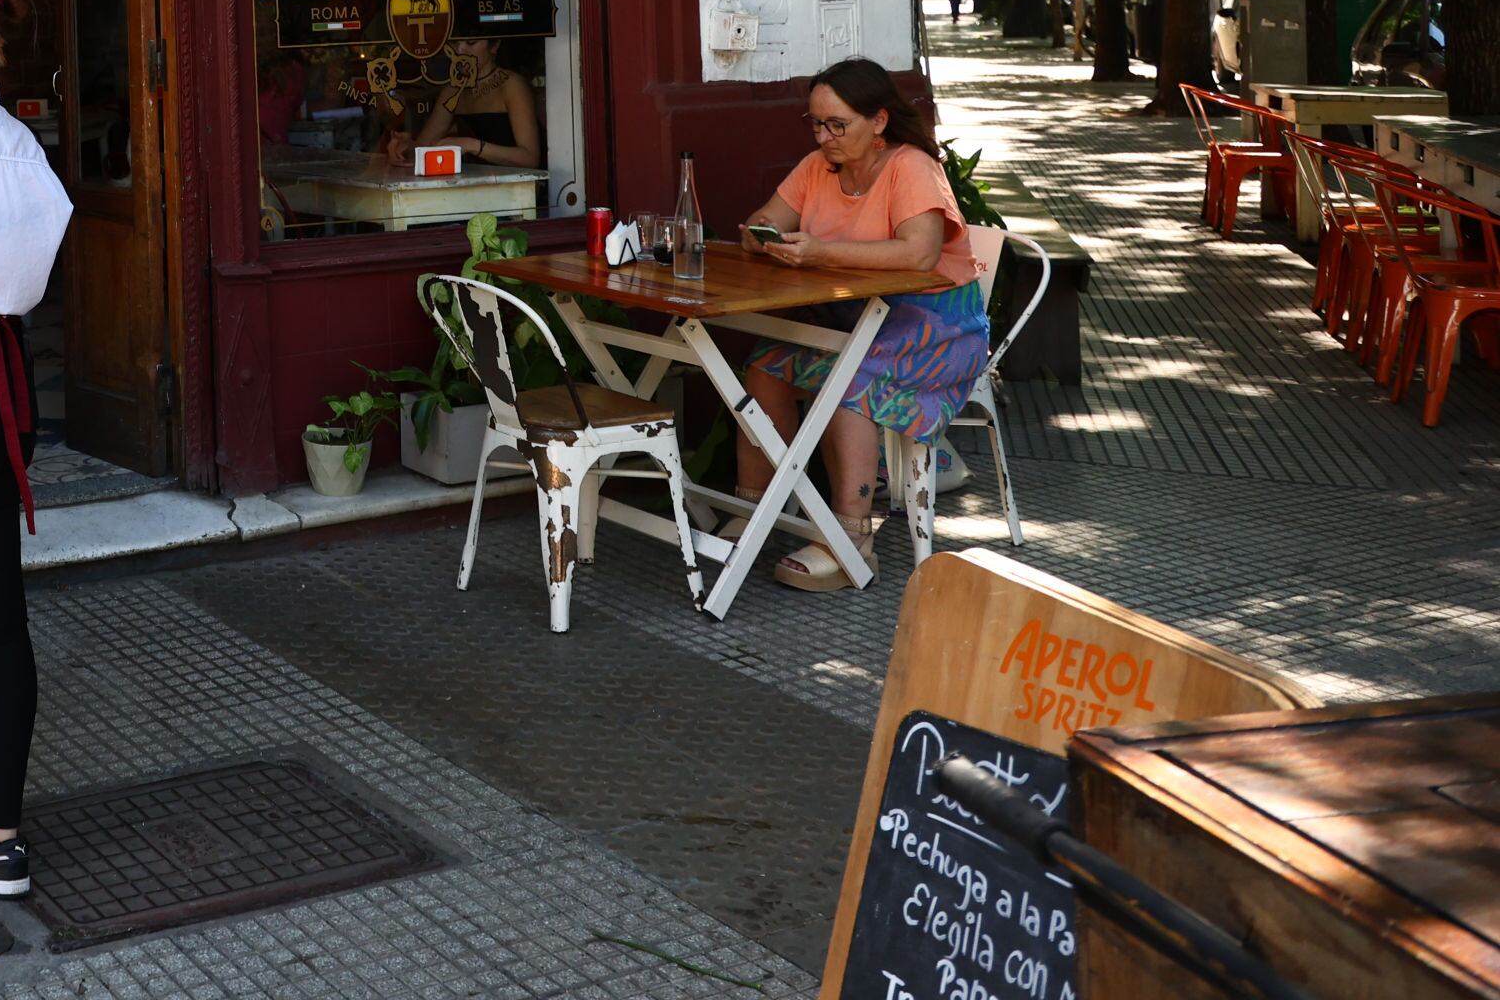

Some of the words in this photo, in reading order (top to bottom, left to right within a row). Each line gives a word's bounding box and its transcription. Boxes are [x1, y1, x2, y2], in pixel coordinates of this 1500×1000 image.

[311, 6, 360, 20] ROMA
[478, 1, 498, 12] BS.
[503, 0, 523, 11] AS.
[338, 81, 377, 107] PINSA
[417, 102, 430, 114] DI
[999, 619, 1155, 711] APEROL
[889, 809, 988, 910] Pechuga
[996, 889, 1011, 918] a
[1019, 891, 1040, 936] la
[903, 883, 994, 973] Elegila
[1004, 950, 1048, 1000] con
